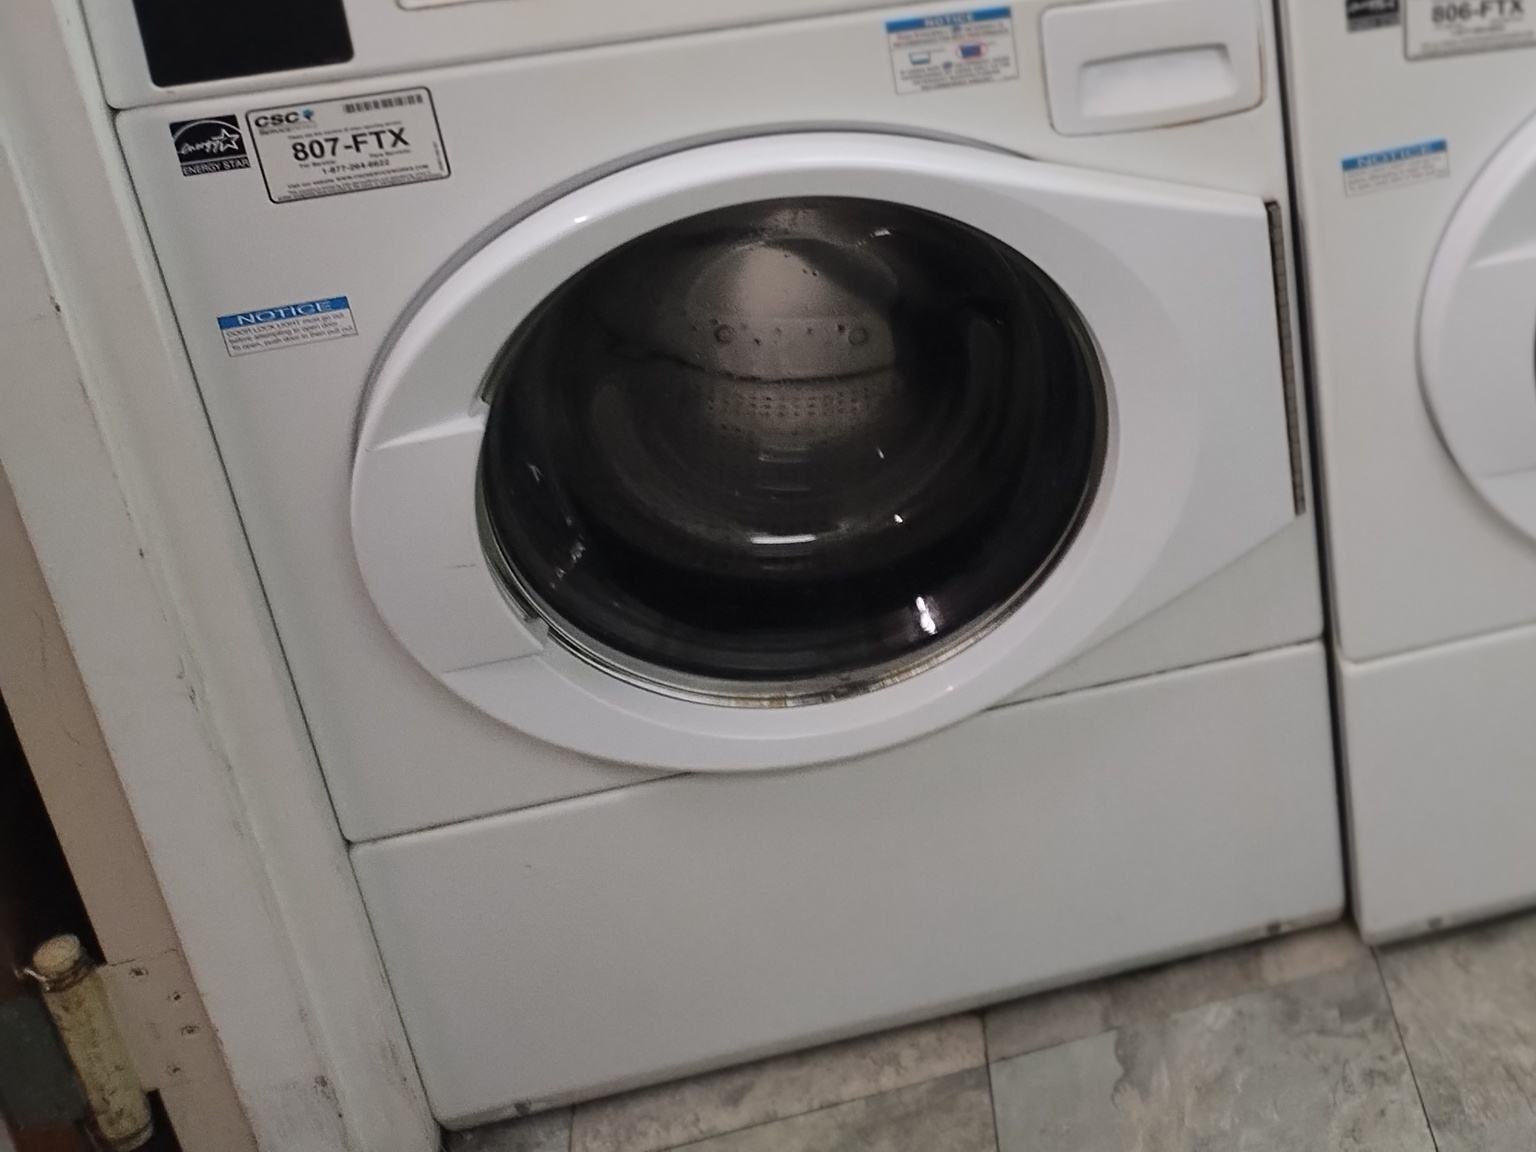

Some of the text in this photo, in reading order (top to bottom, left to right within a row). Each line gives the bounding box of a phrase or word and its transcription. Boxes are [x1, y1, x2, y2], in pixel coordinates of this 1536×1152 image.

[254, 111, 300, 128] CSC
[291, 126, 410, 162] 807-FTX
[222, 157, 250, 170] STAR
[237, 300, 332, 325] NOTICE
